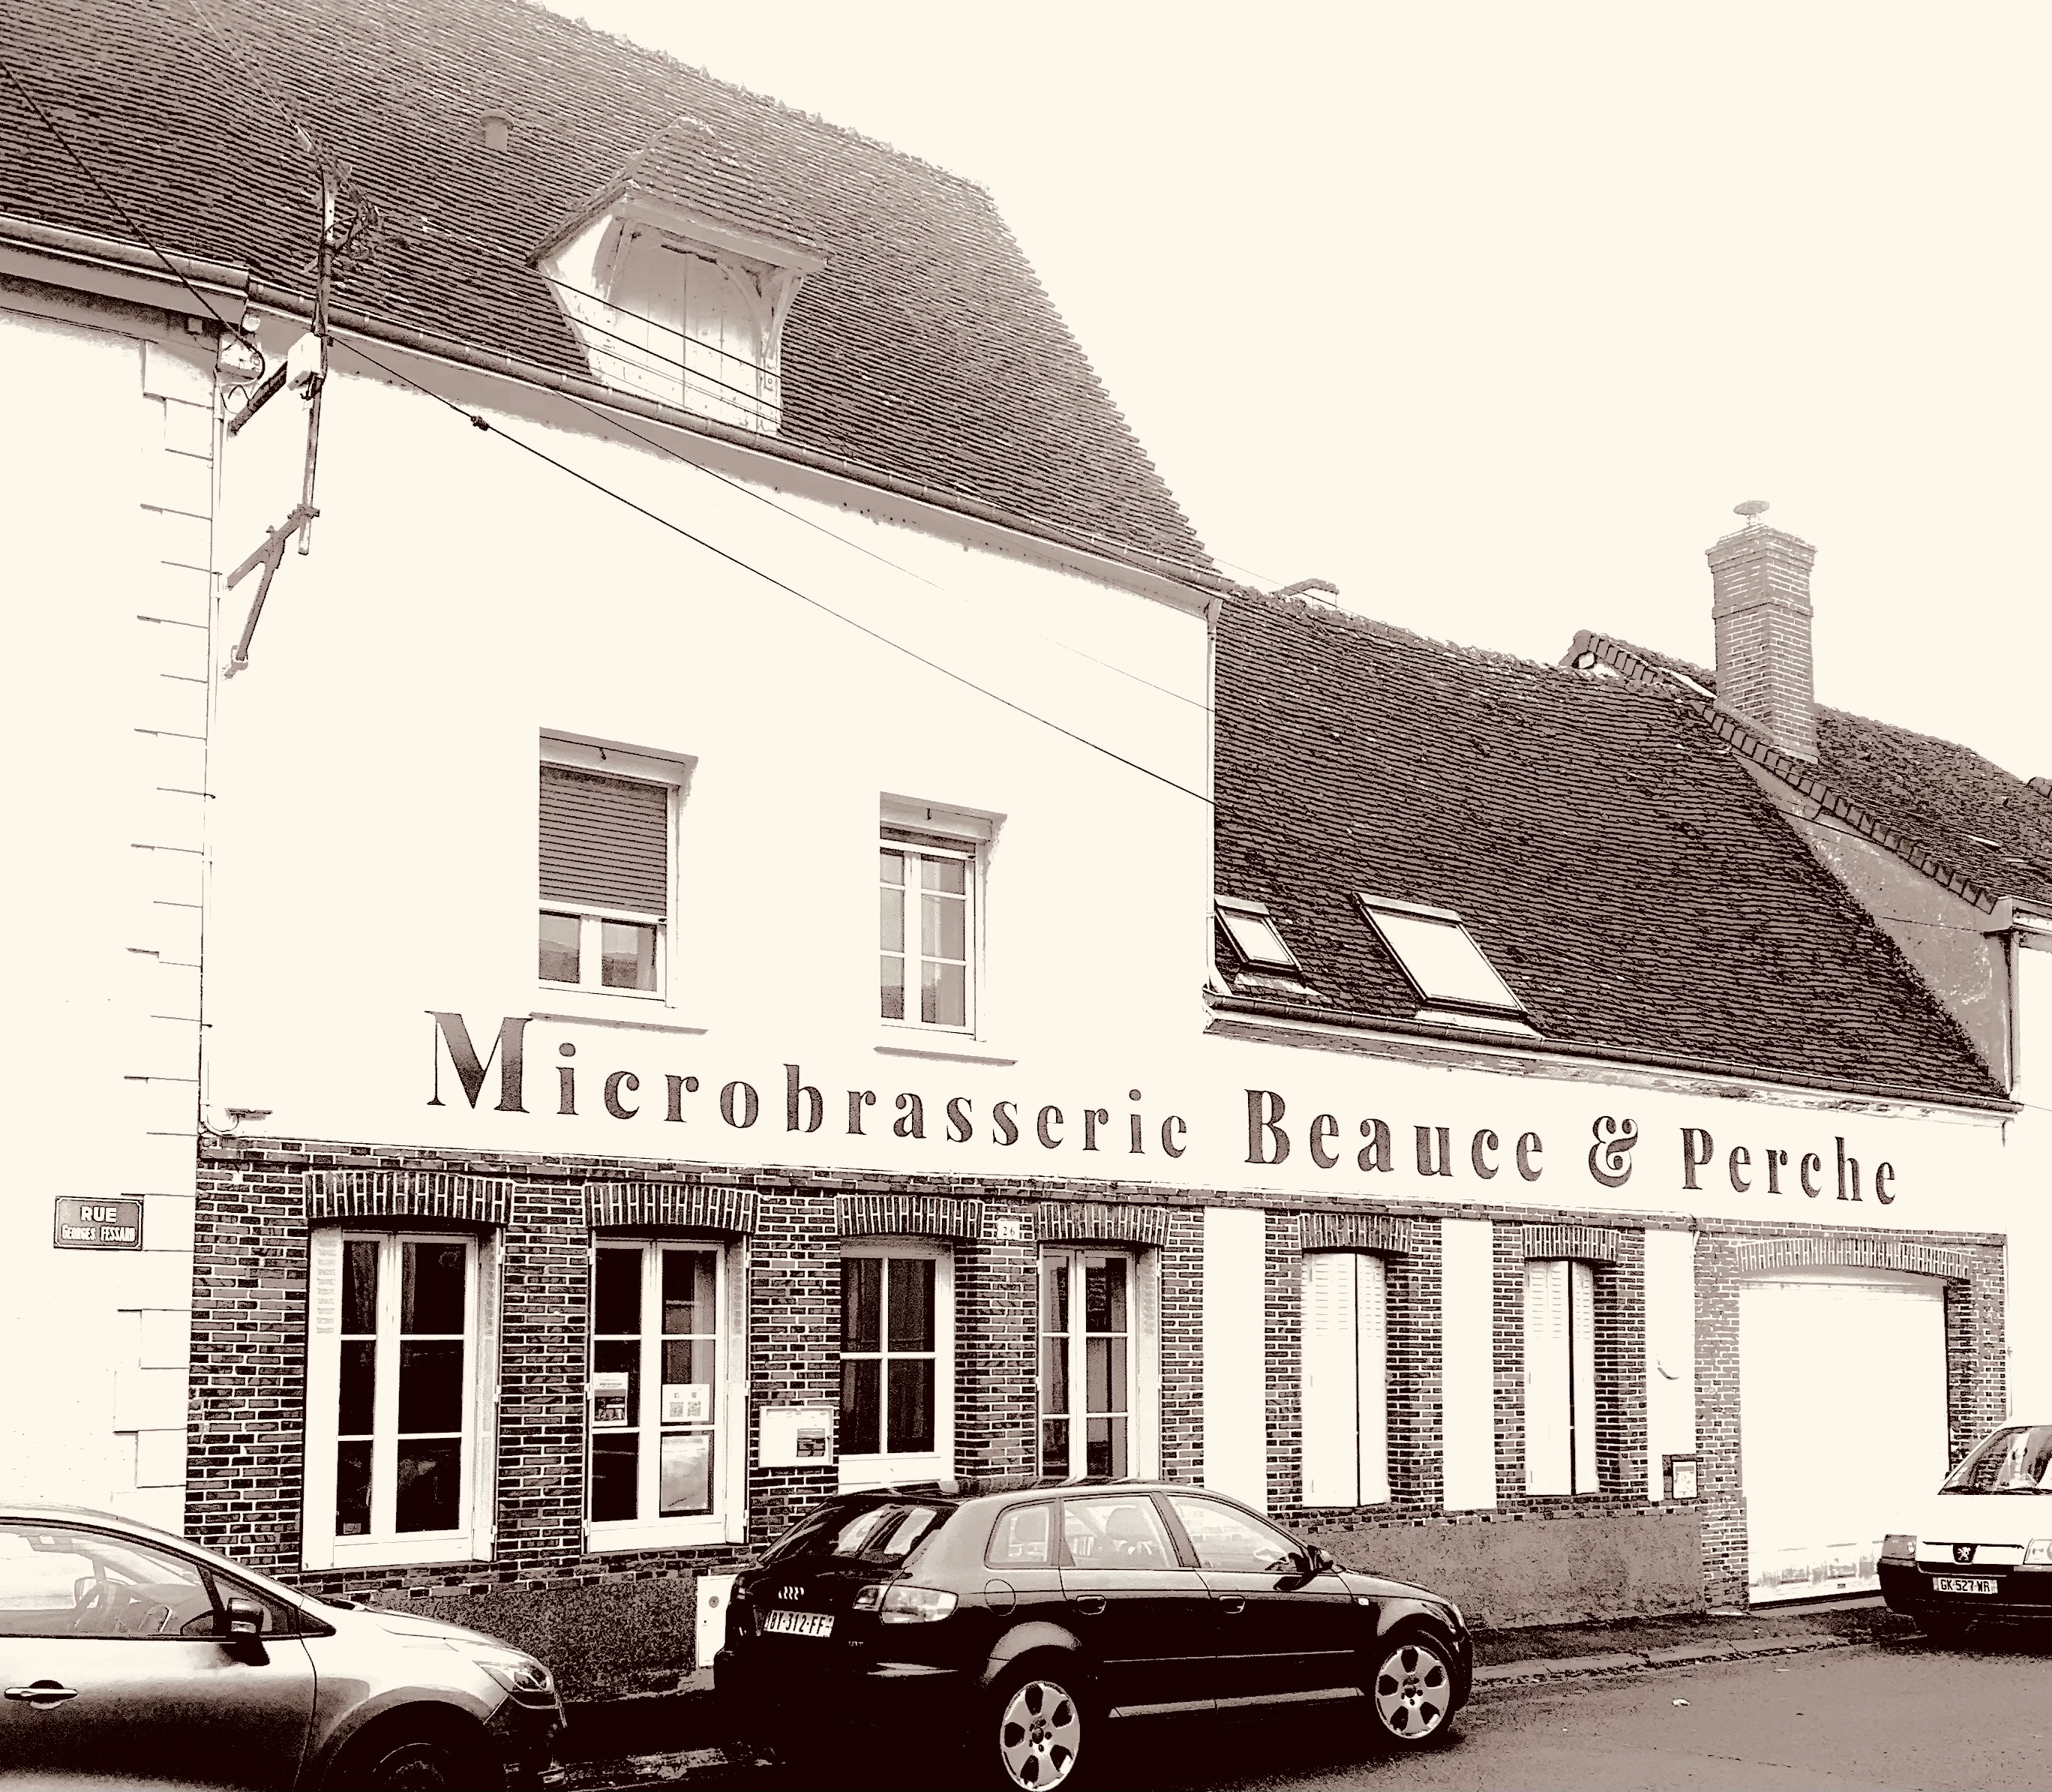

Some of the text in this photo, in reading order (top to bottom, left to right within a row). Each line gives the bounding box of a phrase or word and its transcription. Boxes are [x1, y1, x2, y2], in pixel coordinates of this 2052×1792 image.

[423, 1010, 1897, 1205] Microbrasserie Beauce & Perche
[80, 1205, 117, 1223] RUE
[1003, 1226, 1016, 1236] 26
